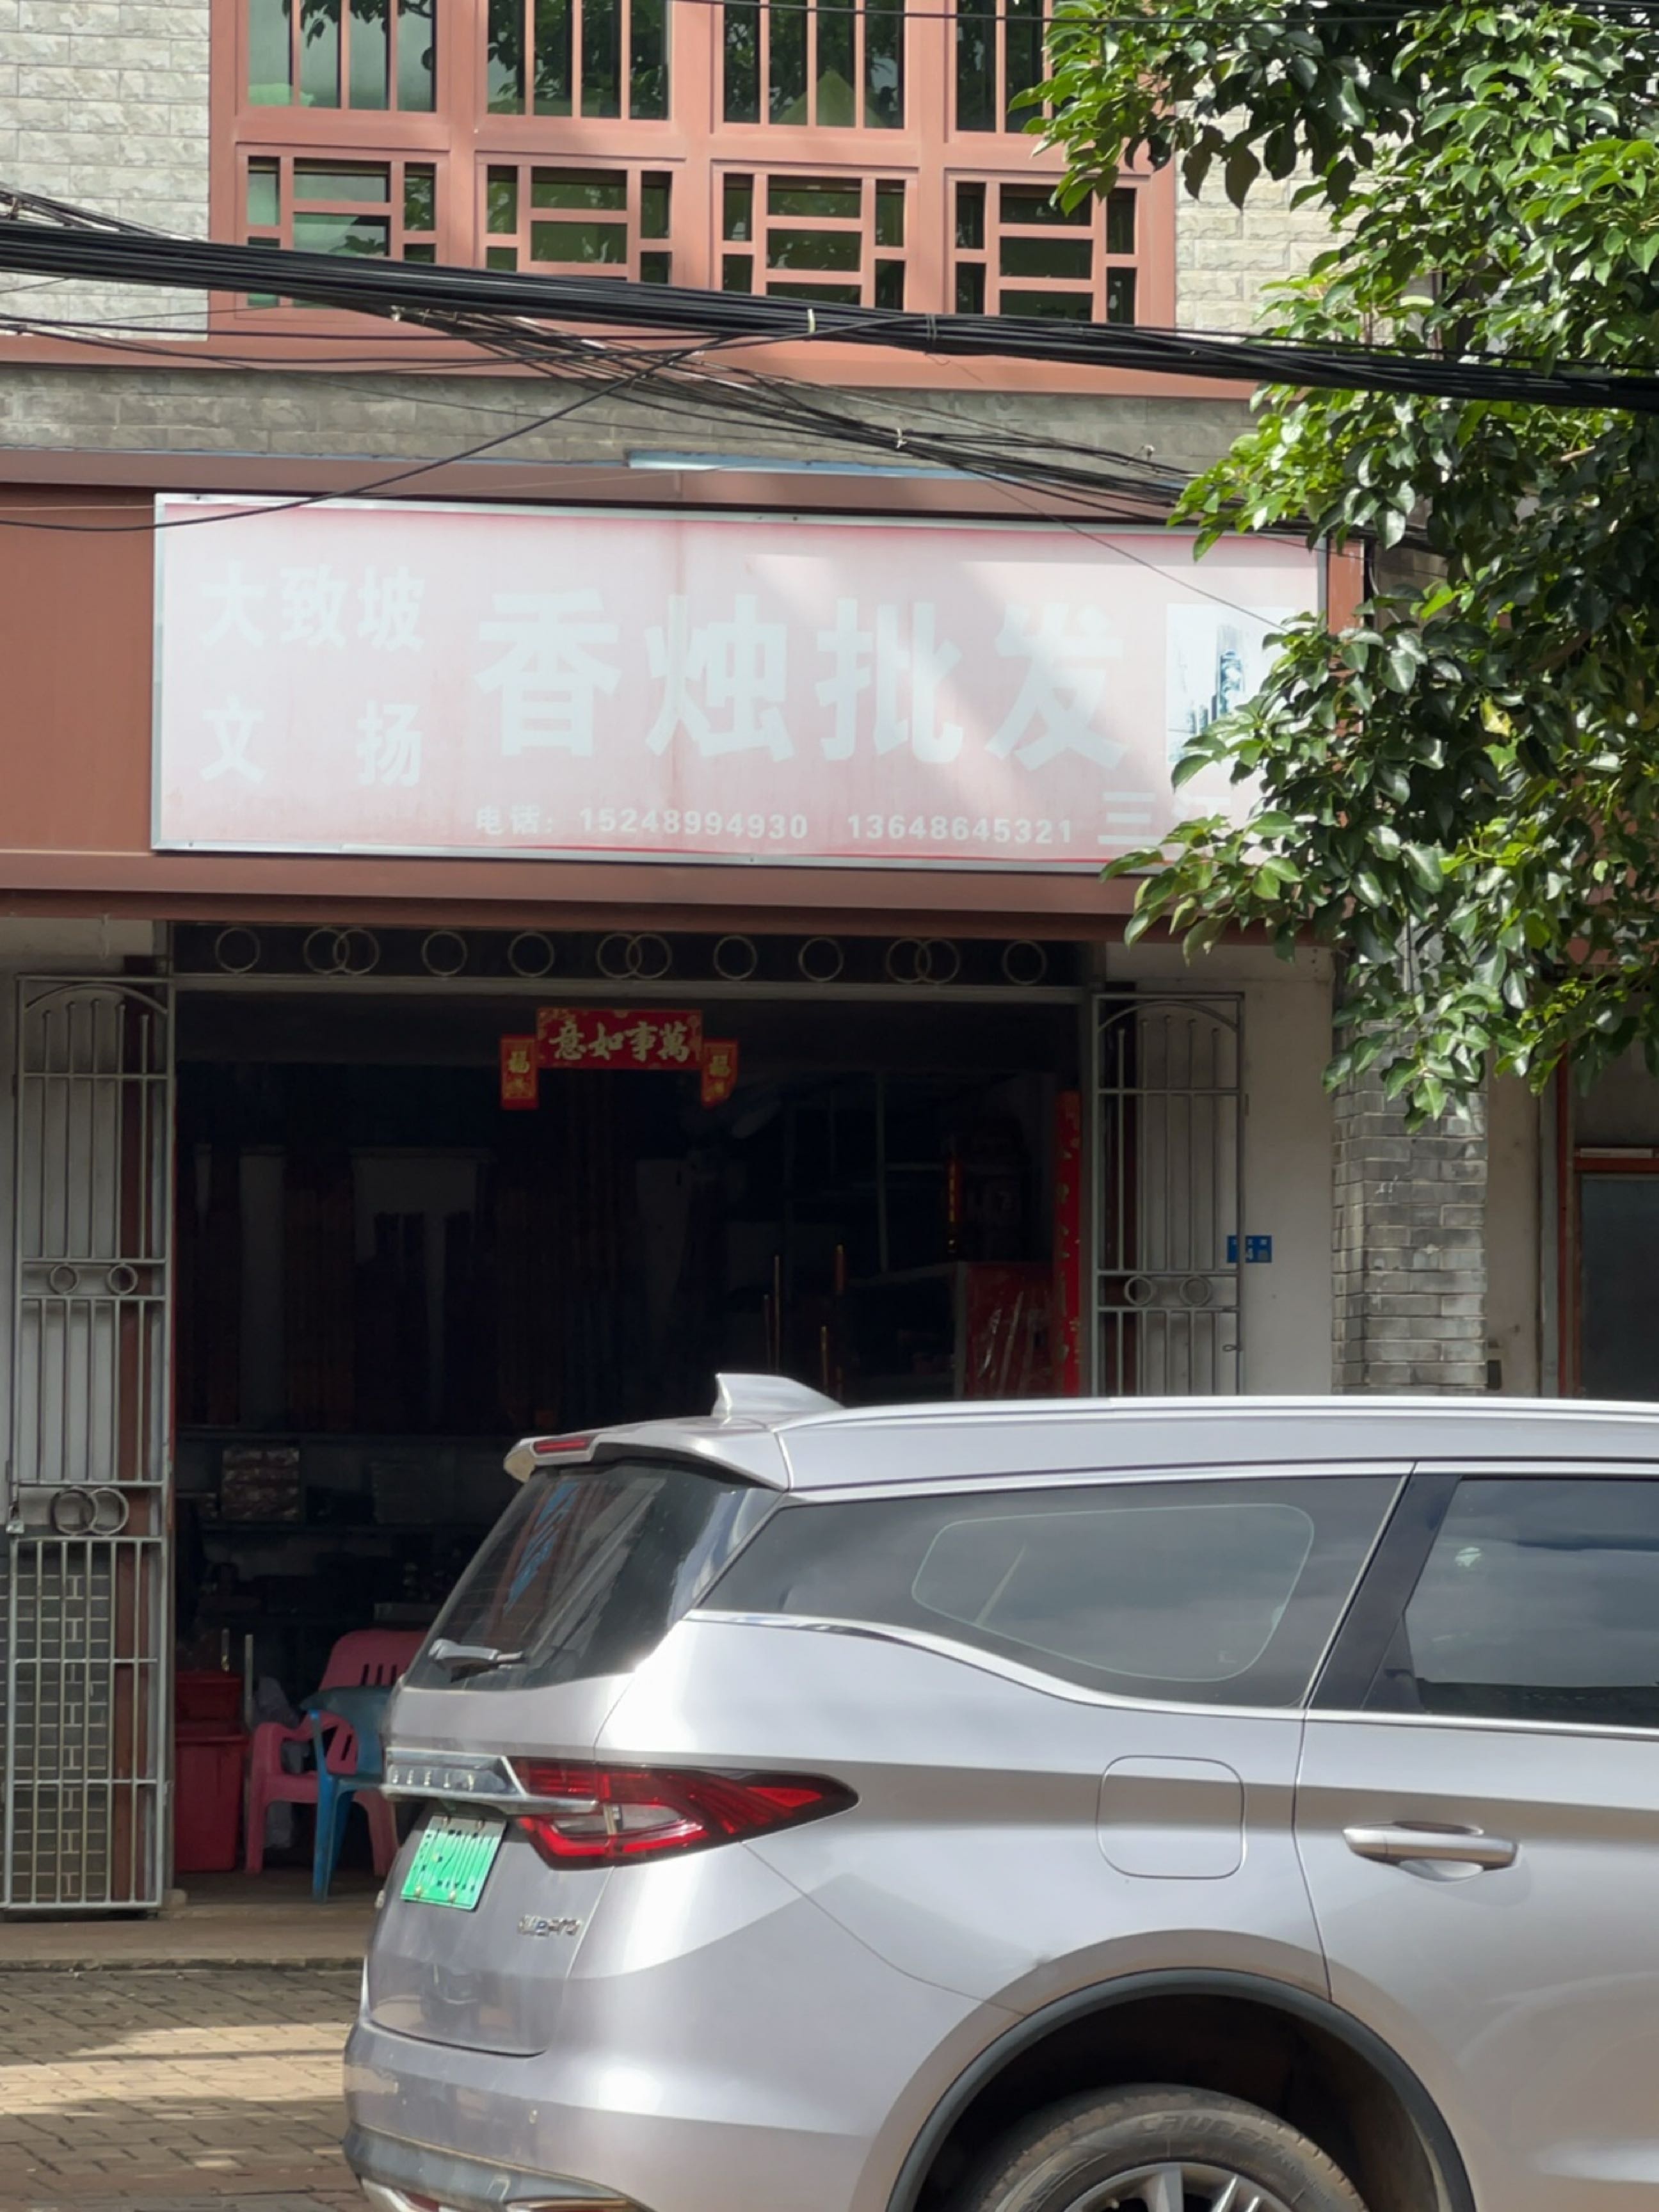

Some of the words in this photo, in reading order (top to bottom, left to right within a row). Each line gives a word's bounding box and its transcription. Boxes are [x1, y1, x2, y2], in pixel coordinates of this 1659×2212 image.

[201, 561, 424, 650] 大致坡
[476, 590, 1126, 770] 香烛批发
[582, 808, 808, 839] 15248994930
[849, 812, 1073, 844] 13648645321
